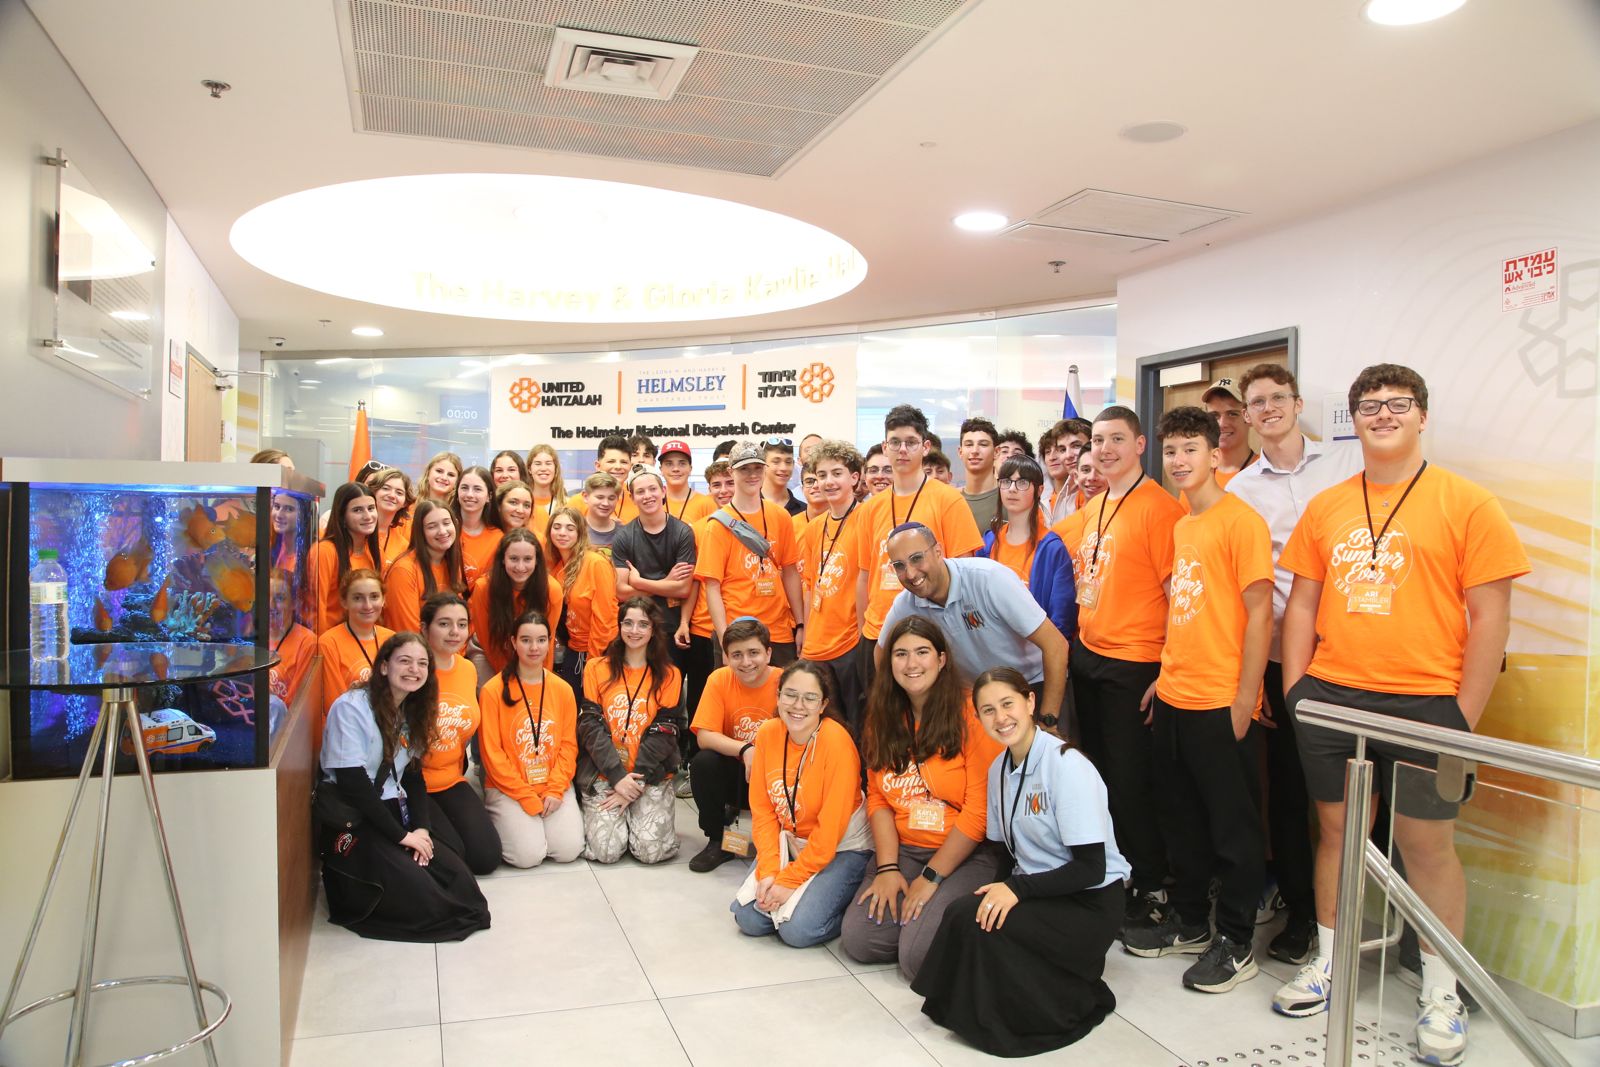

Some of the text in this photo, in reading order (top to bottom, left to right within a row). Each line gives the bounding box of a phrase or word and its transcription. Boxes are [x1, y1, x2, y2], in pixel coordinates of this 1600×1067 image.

[1504, 250, 1555, 272] עמדת
[1504, 262, 1555, 284] כיבוי אש
[411, 272, 467, 302] The
[481, 281, 600, 313] Harvey
[610, 284, 635, 311] &
[642, 281, 734, 310] Gloria
[758, 370, 797, 383] איחוד
[542, 382, 585, 393] UNITED
[637, 375, 726, 394] HELMSLEY
[758, 385, 797, 398] הצלה
[541, 395, 602, 406] HATZALAH
[447, 409, 478, 420] 00:00
[550, 422, 796, 438] The Helmsley National Dispatch Center
[438, 702, 470, 718] Best
[436, 717, 472, 730] ummer
